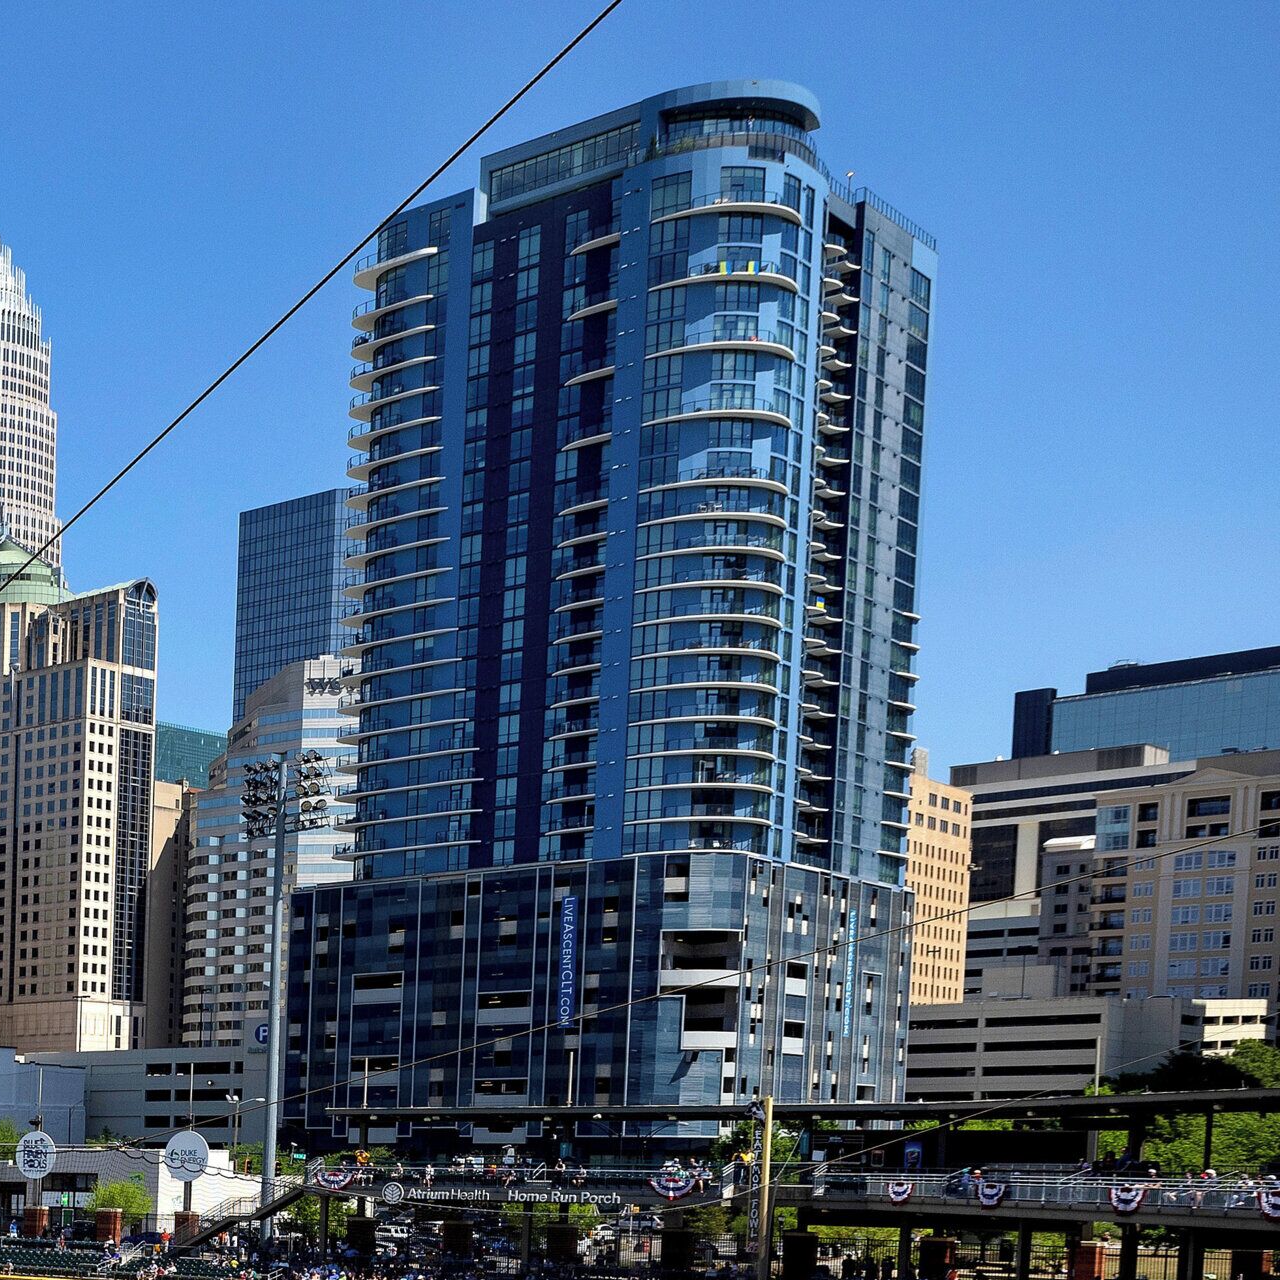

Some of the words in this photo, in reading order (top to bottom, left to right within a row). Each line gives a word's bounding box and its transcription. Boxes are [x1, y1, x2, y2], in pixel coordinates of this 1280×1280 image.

[180, 1149, 197, 1157] DUKE
[753, 1130, 763, 1161] EAT
[23, 1159, 48, 1169] POOLS
[406, 1187, 450, 1200] Atrium
[451, 1188, 491, 1201] Health
[508, 1189, 547, 1203] Home
[551, 1190, 577, 1203] Run
[581, 1191, 621, 1204] Porch
[749, 1200, 759, 1239] FOWL
